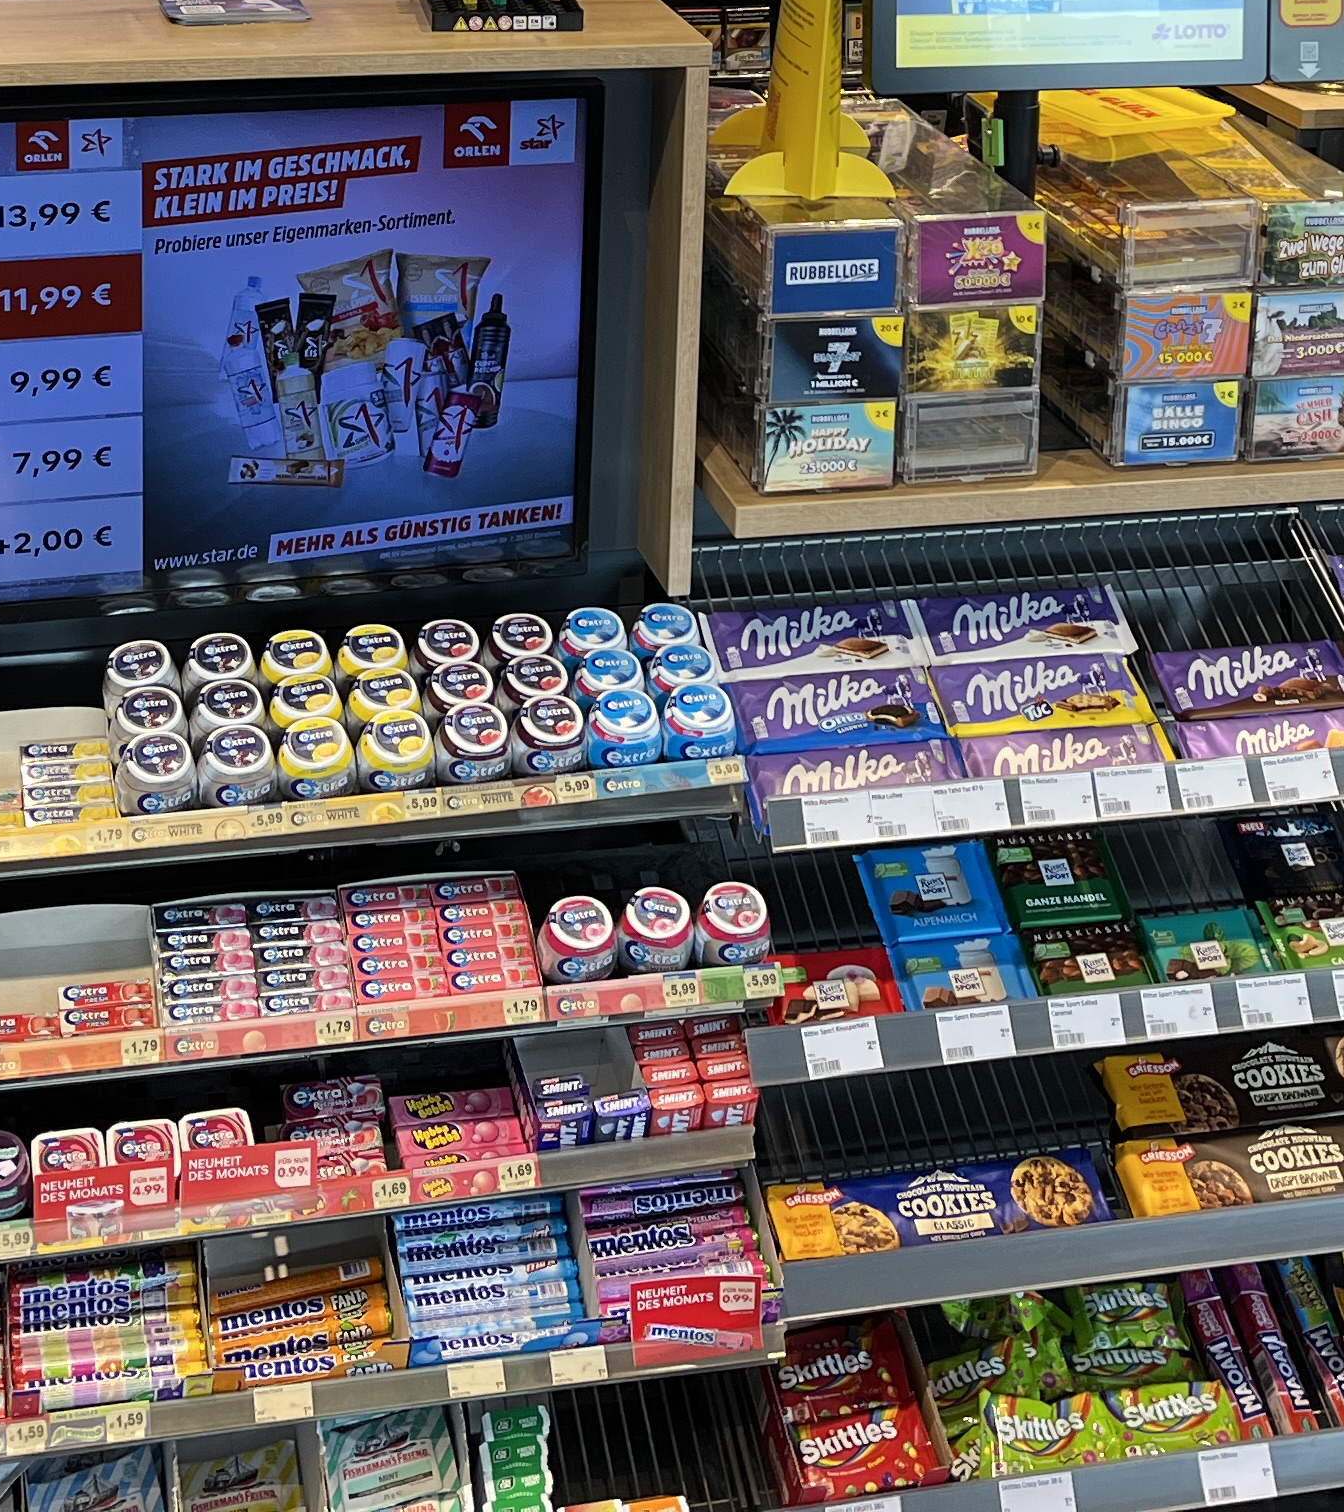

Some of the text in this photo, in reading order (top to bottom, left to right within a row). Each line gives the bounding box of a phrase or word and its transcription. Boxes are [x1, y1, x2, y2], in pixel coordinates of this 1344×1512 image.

[1174, 23, 1227, 40] LOTTO
[453, 145, 502, 158] ORLEN
[154, 144, 412, 191] STARK IM GESCHMACK,
[91, 200, 111, 223] €
[154, 209, 457, 256] Probiere unser Eigenmarken-Sortiment.
[1310, 235, 1344, 257] Wege
[789, 262, 876, 281] RUBBELLOSE
[91, 283, 111, 306] €
[9, 364, 112, 398] 9,99 €
[1151, 418, 1204, 430] BINGO
[788, 437, 872, 458] HOLIDAY
[276, 531, 336, 557] MEHR
[340, 526, 379, 548] ALS
[384, 514, 472, 542] GÜNSTIG
[476, 502, 564, 529] TANKEN!
[153, 544, 258, 572] www.star.de
[952, 592, 1062, 646] Milka
[740, 604, 857, 661] Milka
[1186, 645, 1296, 700] Milka
[818, 713, 863, 733] OREO
[1025, 893, 1108, 908] GANZE MANDEL
[349, 909, 400, 928] extra
[913, 912, 978, 928] ALPENMILCH
[1234, 1063, 1325, 1090] COOKIES
[188, 1155, 243, 1170] NEUHEIT
[188, 1163, 270, 1181] DES MONATS
[218, 1289, 369, 1333] mentos FANTA
[798, 1417, 898, 1467] Skittles
